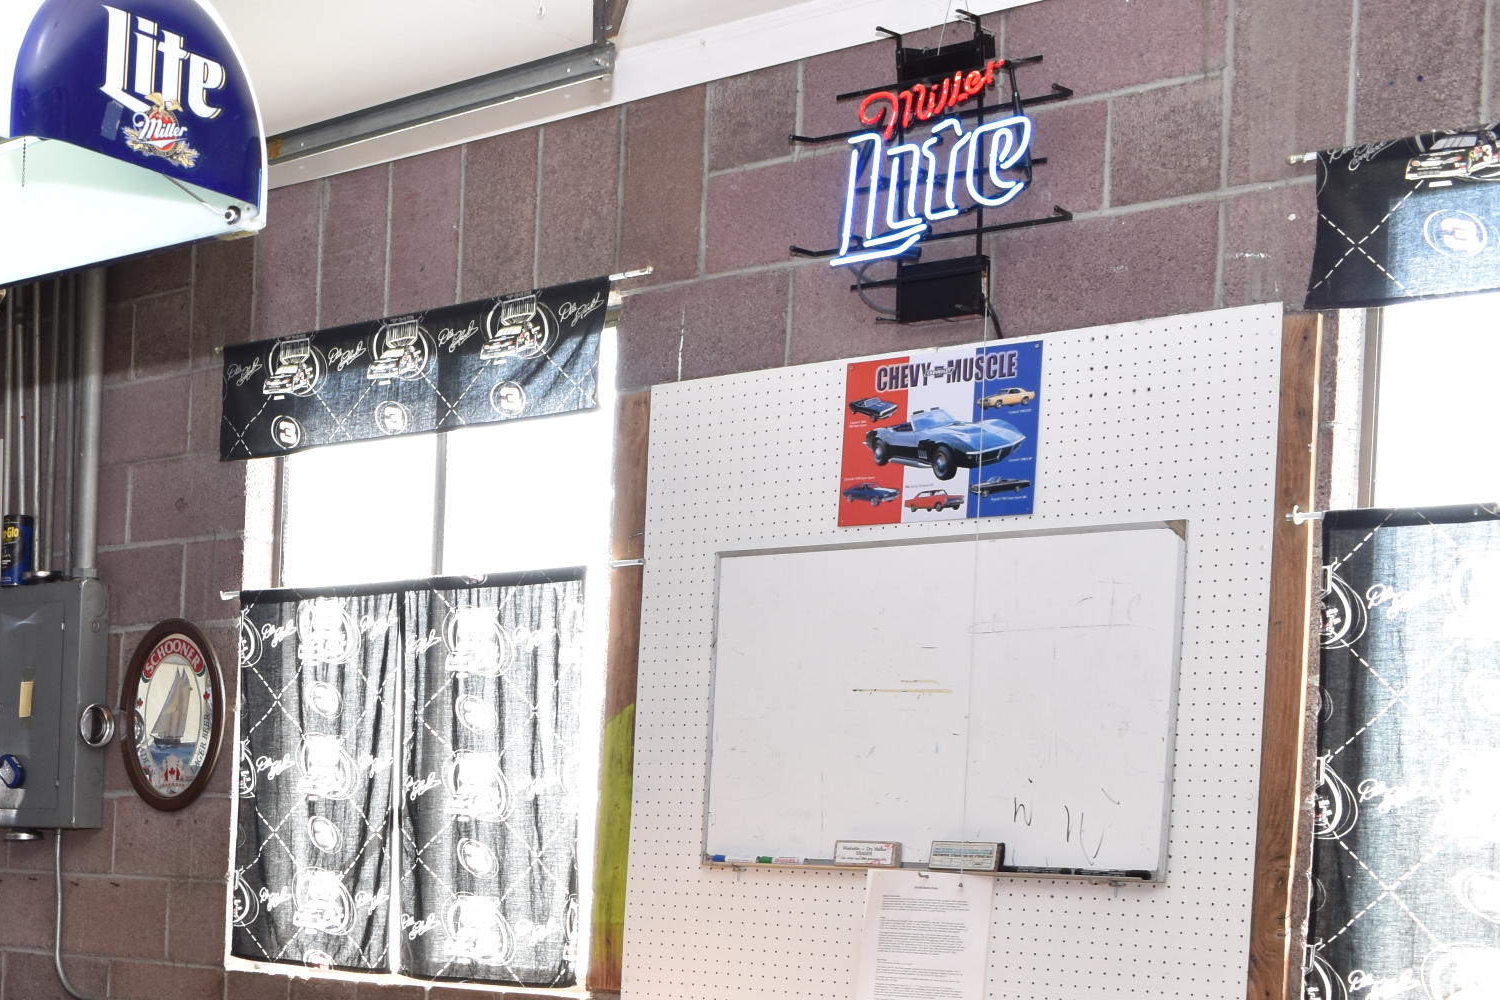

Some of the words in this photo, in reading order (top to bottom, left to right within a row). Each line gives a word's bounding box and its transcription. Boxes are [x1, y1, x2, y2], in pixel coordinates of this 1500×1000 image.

[99, 4, 226, 119] Lite
[859, 59, 1006, 141] Miller
[132, 111, 188, 140] Miller
[829, 115, 1032, 267] Lite
[875, 362, 932, 392] CHEVY
[946, 351, 1018, 384] MUSCLE
[500, 387, 521, 413] 3
[279, 420, 297, 445] 3
[384, 406, 403, 430] 3
[145, 640, 201, 674] SCHOONER
